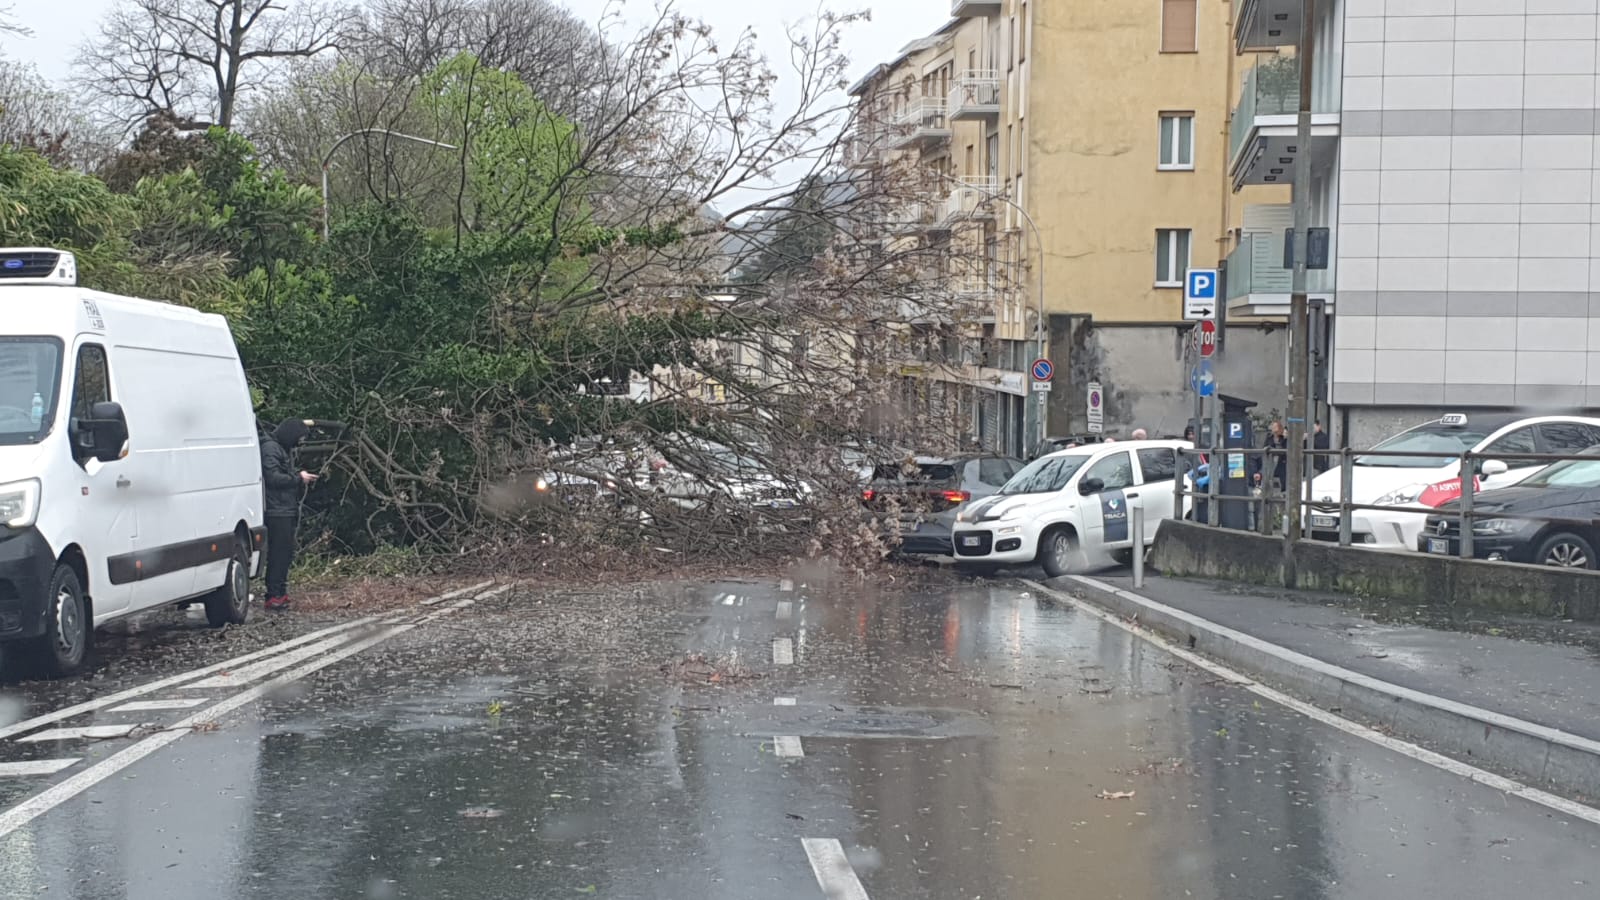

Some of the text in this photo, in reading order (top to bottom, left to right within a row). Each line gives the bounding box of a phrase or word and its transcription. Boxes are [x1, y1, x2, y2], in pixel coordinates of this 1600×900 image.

[1193, 275, 1210, 296] P
[1195, 331, 1215, 345] TOP
[1230, 423, 1241, 436] P
